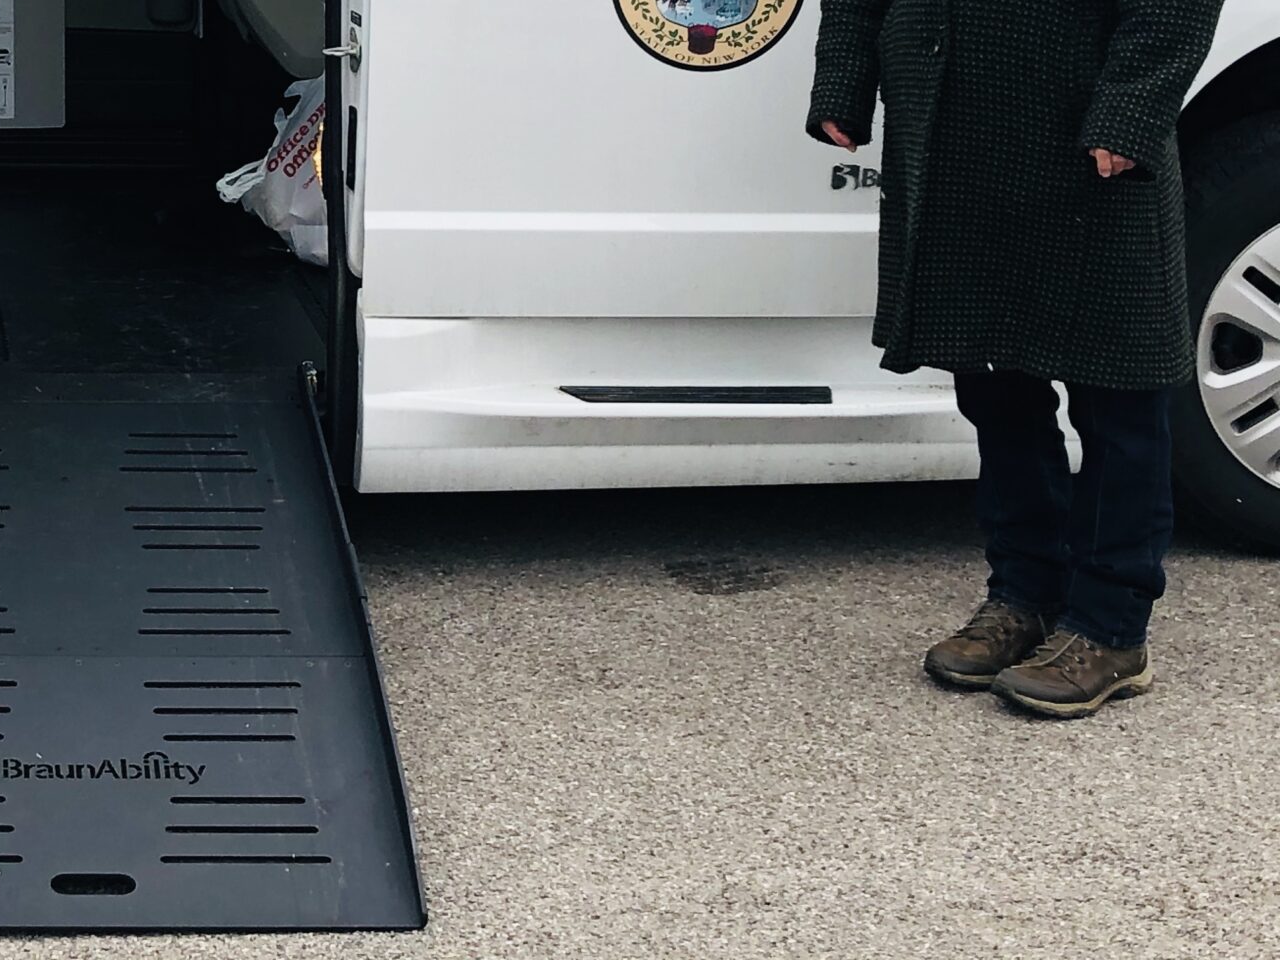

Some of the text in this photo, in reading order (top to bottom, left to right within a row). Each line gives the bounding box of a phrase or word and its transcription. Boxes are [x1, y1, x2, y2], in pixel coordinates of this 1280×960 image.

[632, 21, 779, 65] STATE OF NEW YORK
[267, 125, 310, 173] Office
[3, 751, 207, 785] BraunAbility
